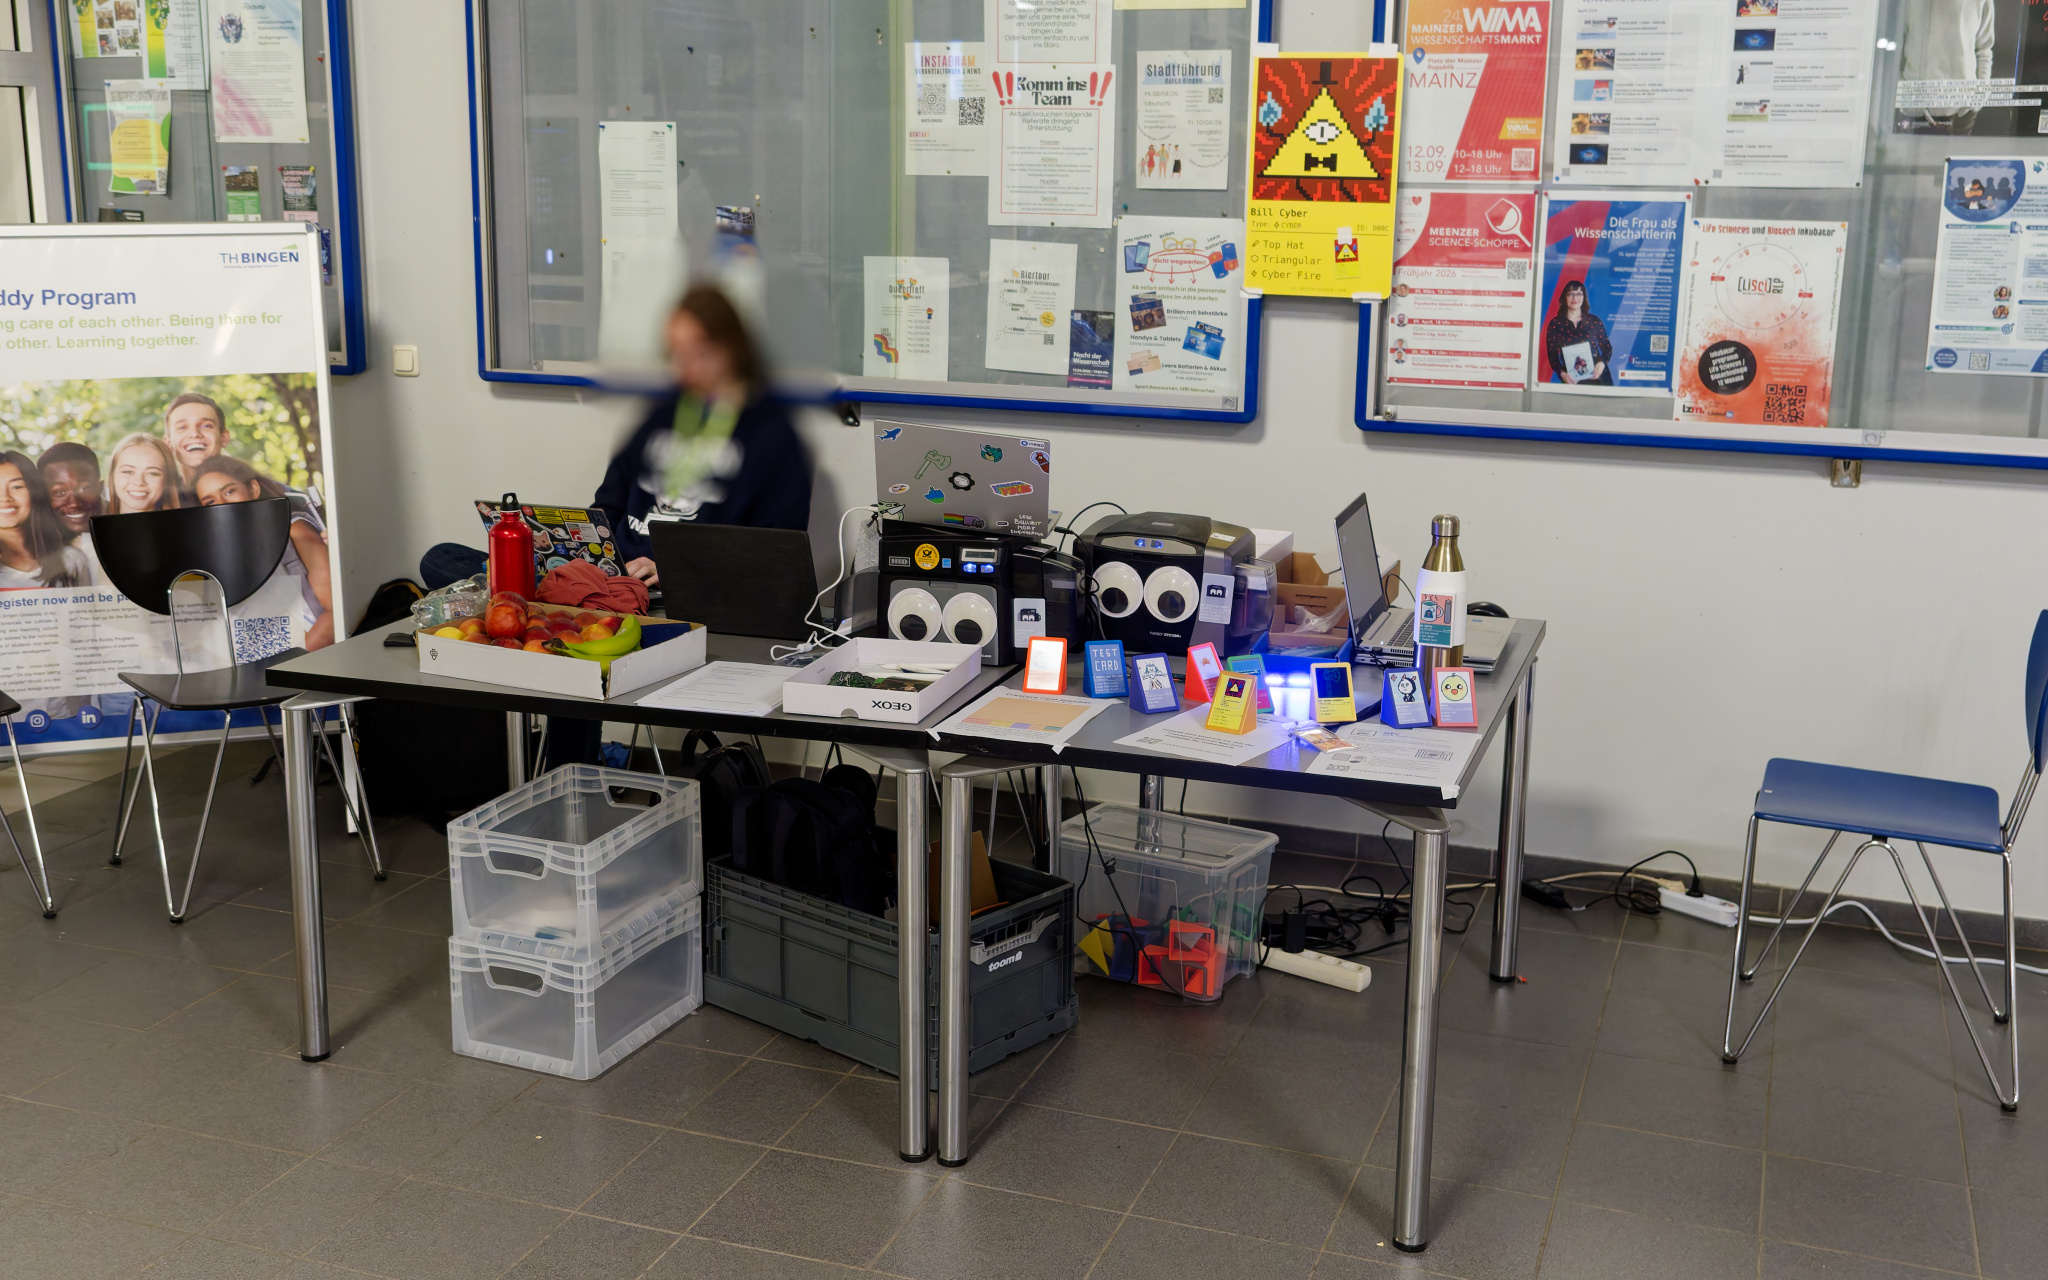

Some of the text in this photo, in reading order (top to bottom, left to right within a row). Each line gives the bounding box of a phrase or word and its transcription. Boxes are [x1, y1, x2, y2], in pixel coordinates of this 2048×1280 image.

[1463, 7, 1542, 32] WIMA
[1412, 24, 1463, 33] MAINZER
[1411, 35, 1541, 45] WISSENSCHAFTSMARKT
[921, 56, 976, 67] INSTAGRAM
[1146, 63, 1221, 77] Stadtführung
[1017, 76, 1088, 91] Komm ins
[1410, 72, 1477, 88] MAINZ
[1032, 92, 1072, 105] Team
[1408, 146, 1446, 158] 12.09.
[1486, 150, 1502, 158] Uhr
[1407, 161, 1446, 172] 13.09.
[1485, 165, 1502, 174] Uhr
[1251, 208, 1308, 219] Bill Cyber
[1610, 216, 1677, 228] Die Frau als
[1429, 227, 1479, 236] MEENZER
[1575, 227, 1676, 240] Wissenschaftlerin
[1702, 224, 1835, 236] Life Sciences und Biotech Inkubator
[1263, 240, 1304, 249] Top Hat
[1429, 237, 1520, 248] SCIENCE-SCHOPPE
[219, 251, 299, 263] TH BINGEN
[1263, 255, 1322, 266] Triangular
[1021, 270, 1050, 280] Biertour
[1262, 270, 1321, 280] Cyber Fire
[1399, 269, 1456, 278] Frühjahr 2026
[41, 289, 136, 310] Program
[19, 312, 282, 329] care of each other. Being there for
[6, 334, 199, 350] other. Learning together.
[1073, 358, 1110, 366] Wissenschaft
[42, 597, 68, 605] now
[72, 594, 94, 603] and
[98, 593, 113, 602] be
[1092, 649, 1117, 658] TEST
[1095, 660, 1119, 672] CARD
[871, 700, 912, 712] GEOX
[988, 955, 1017, 972] toom
